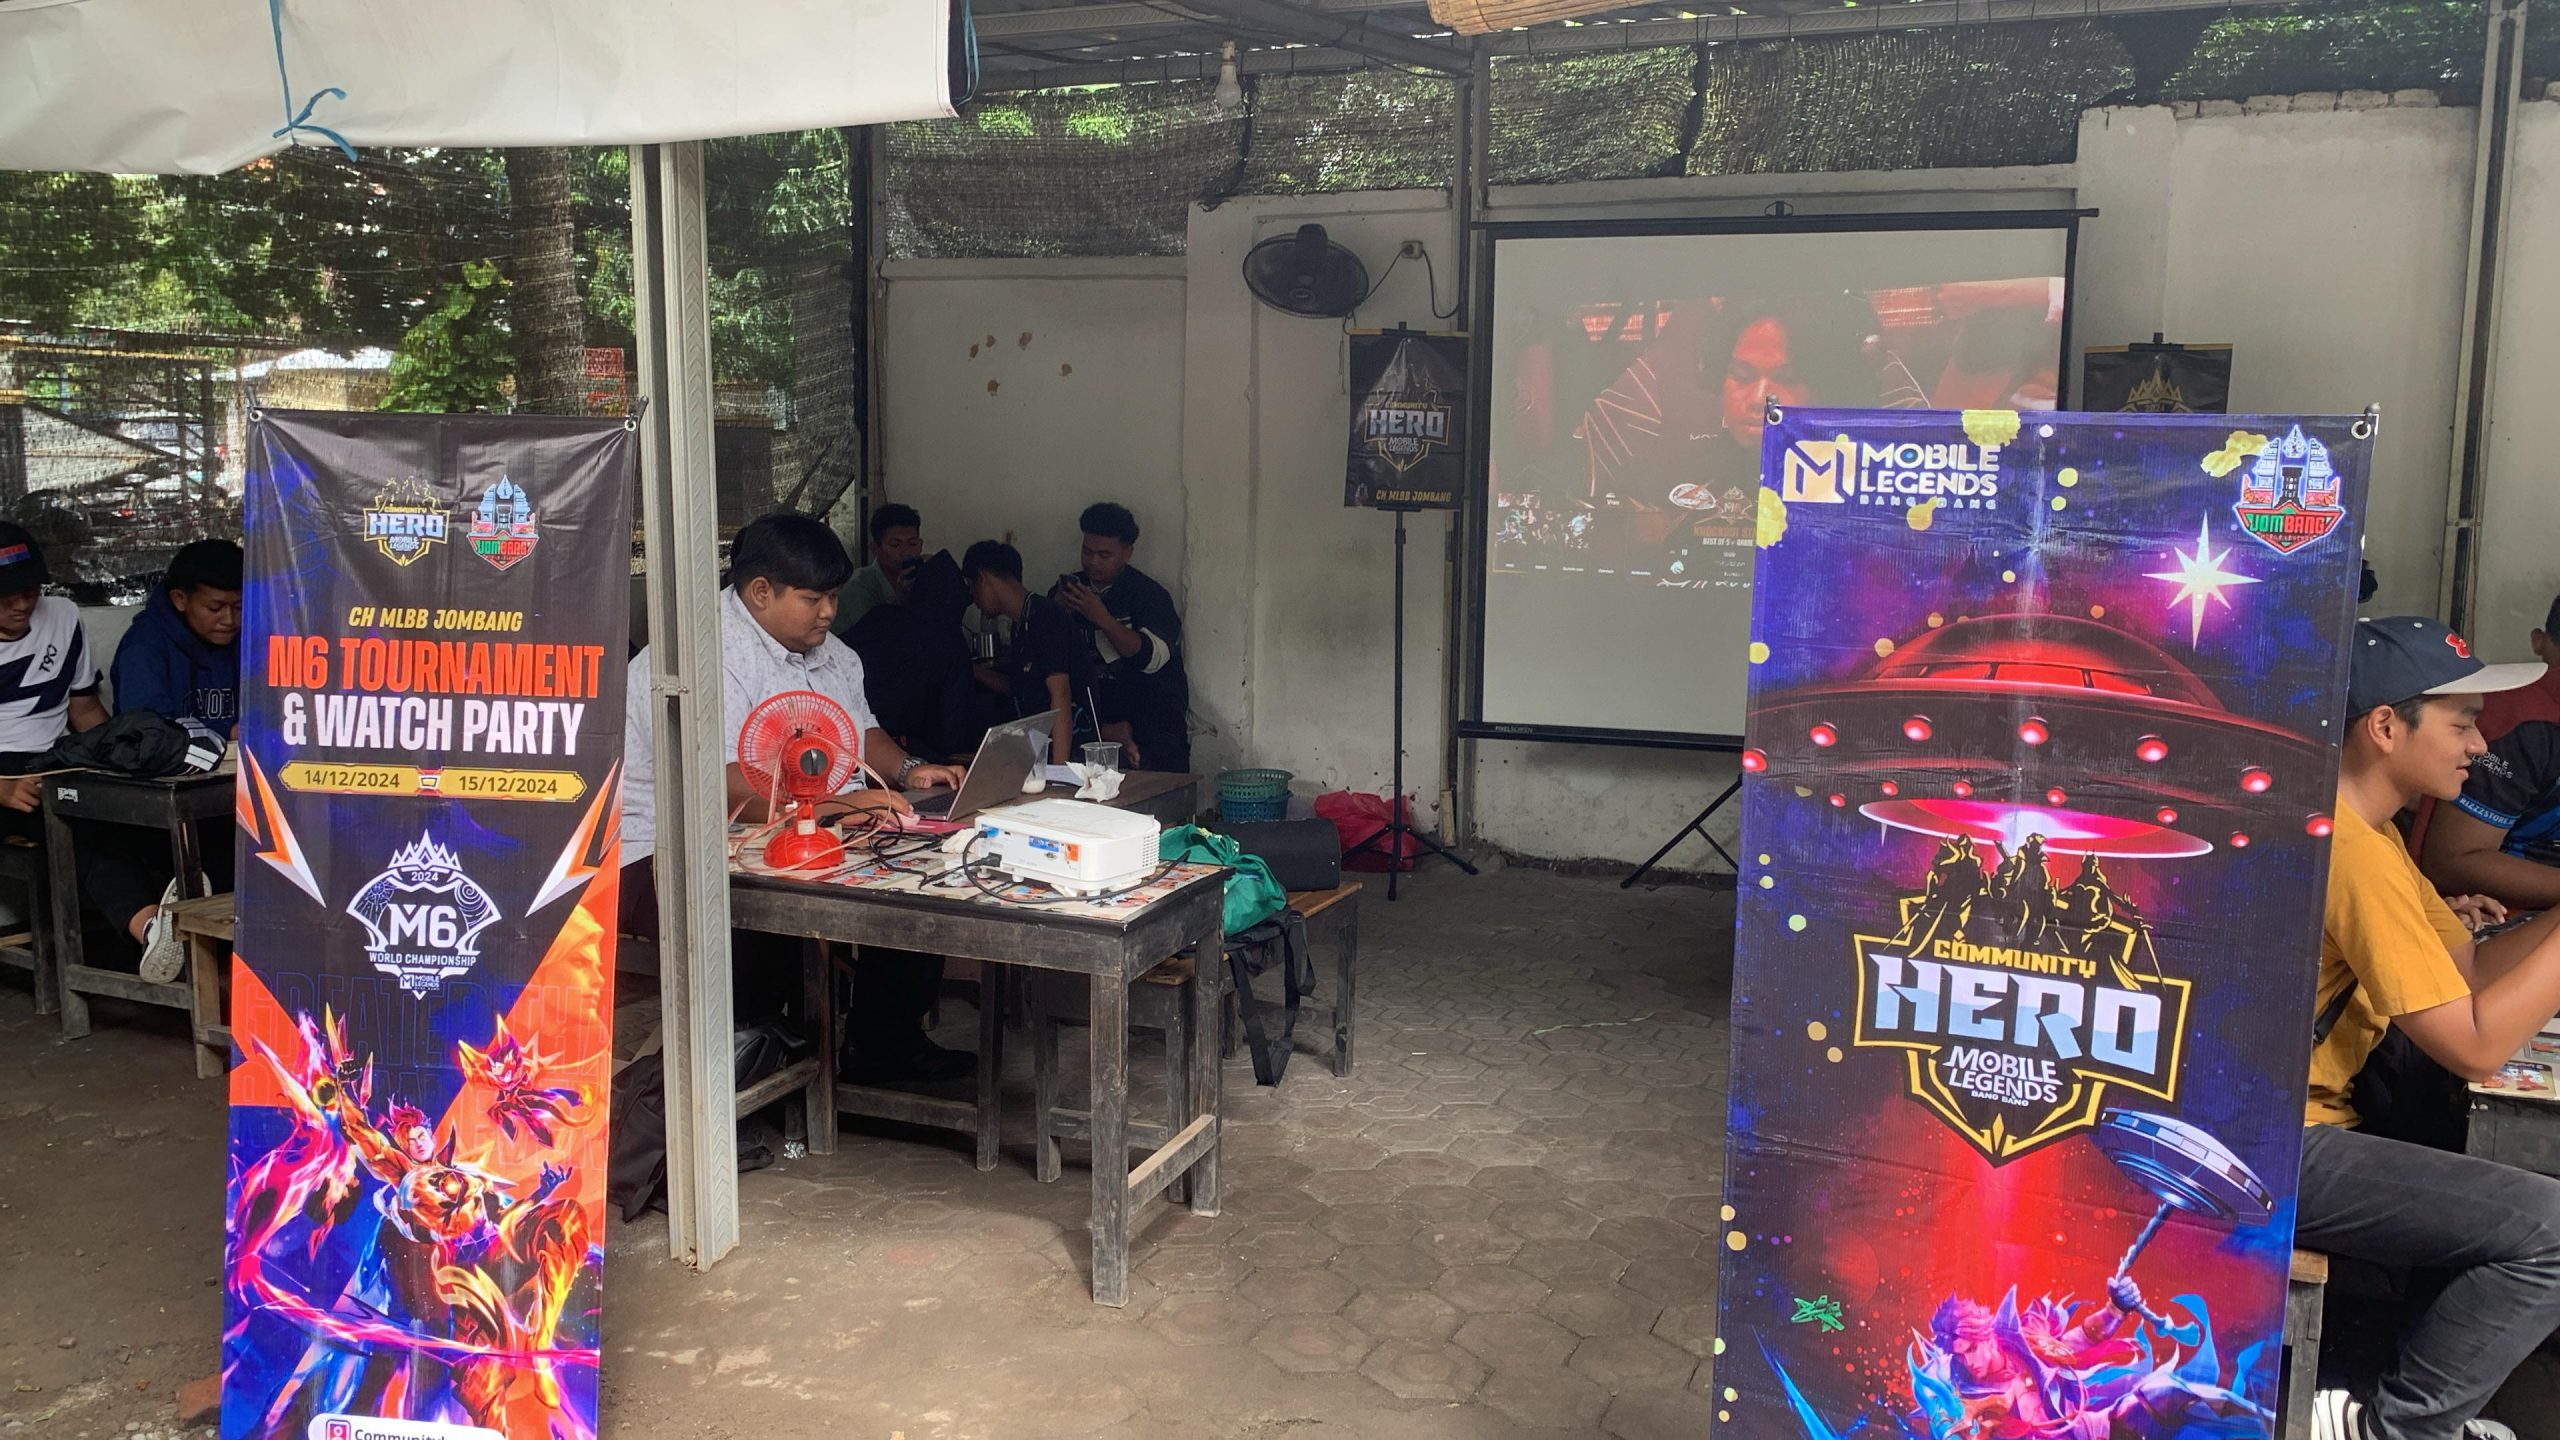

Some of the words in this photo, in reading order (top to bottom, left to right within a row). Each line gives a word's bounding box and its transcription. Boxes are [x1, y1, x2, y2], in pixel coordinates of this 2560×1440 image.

[1369, 409, 1445, 437] HERO
[1862, 442, 2000, 471] MOBILE
[1376, 489, 1388, 500] CH
[1412, 490, 1452, 503] JOMBANG
[1860, 470, 1998, 496] LEGENDS
[368, 513, 444, 537] HERO
[2249, 513, 2326, 533] JOMBANG
[477, 540, 528, 555] JOMBANG
[349, 606, 373, 628] CH
[379, 608, 428, 629] MLBB
[434, 609, 523, 632] JOMBANG
[268, 635, 329, 690] M6
[340, 637, 605, 699] TOURNAMENT
[283, 692, 307, 746] &
[314, 694, 453, 752] WATCH
[463, 699, 585, 756] PARTY
[2472, 753, 2514, 779] LEGENDS
[304, 769, 400, 788] 14/12/2024
[458, 776, 557, 795] 15/12/2024
[411, 871, 439, 882] 2024
[387, 903, 458, 948] M6
[369, 952, 402, 964] WORLD
[404, 953, 477, 967] CHAMPIONSHIP
[1933, 938, 2097, 979] COMMUNITY
[1868, 952, 2162, 1076] HERO
[1942, 1045, 2063, 1086] MOBILE
[1948, 1067, 2058, 1104] LEGENDS
[1971, 1089, 1999, 1101] BANG
[2002, 1094, 2030, 1107] BANG
